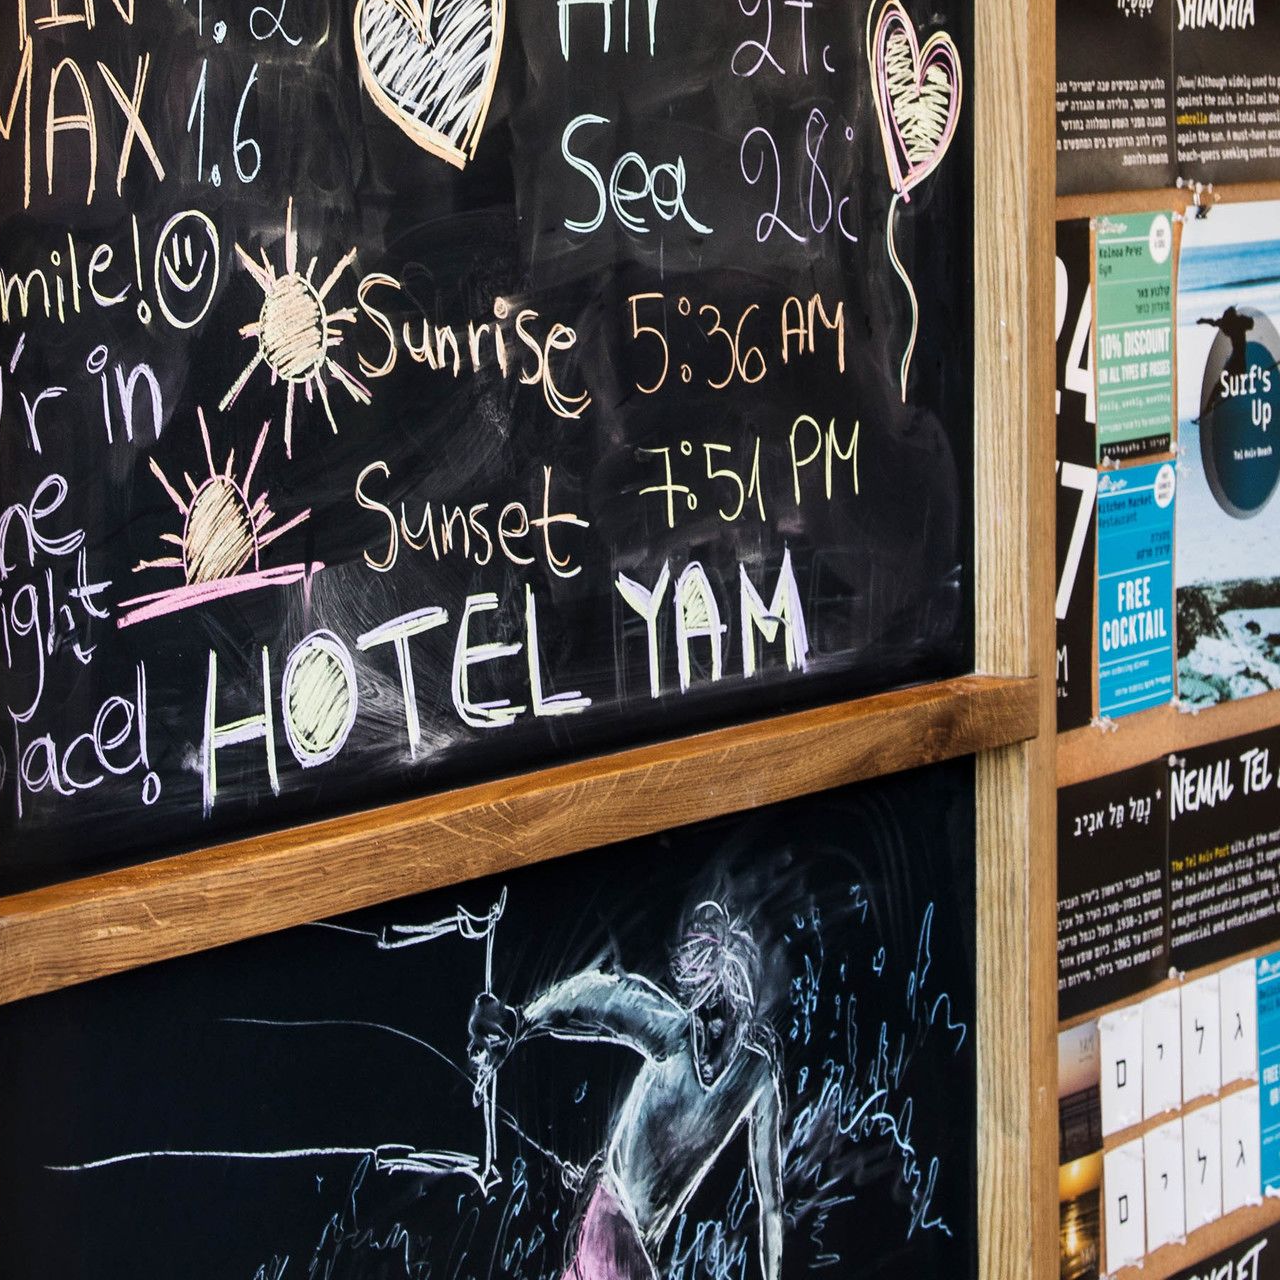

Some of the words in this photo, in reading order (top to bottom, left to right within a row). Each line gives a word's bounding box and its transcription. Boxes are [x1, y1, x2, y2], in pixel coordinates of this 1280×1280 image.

[186, 57, 262, 187] 1.6
[561, 112, 714, 235] Sea
[357, 272, 593, 420] Sunrise
[628, 292, 768, 395] 5:36
[781, 293, 846, 374] AM
[1099, 332, 1122, 362] 10%
[1122, 326, 1171, 358] DISCOUNT
[1220, 364, 1272, 398] Surf's
[85, 344, 164, 445] in
[1251, 398, 1272, 432] Up
[355, 460, 590, 579] Sunset
[636, 436, 767, 529] 7:51
[788, 414, 861, 506] PM
[1101, 607, 1168, 653] COCKTAIL
[1116, 575, 1152, 614] FREE
[202, 583, 593, 819] HOTEL
[615, 540, 810, 701] YAM
[1170, 758, 1235, 821] NEMAL
[1238, 747, 1273, 796] TEL
[1262, 1063, 1280, 1086] FREE
